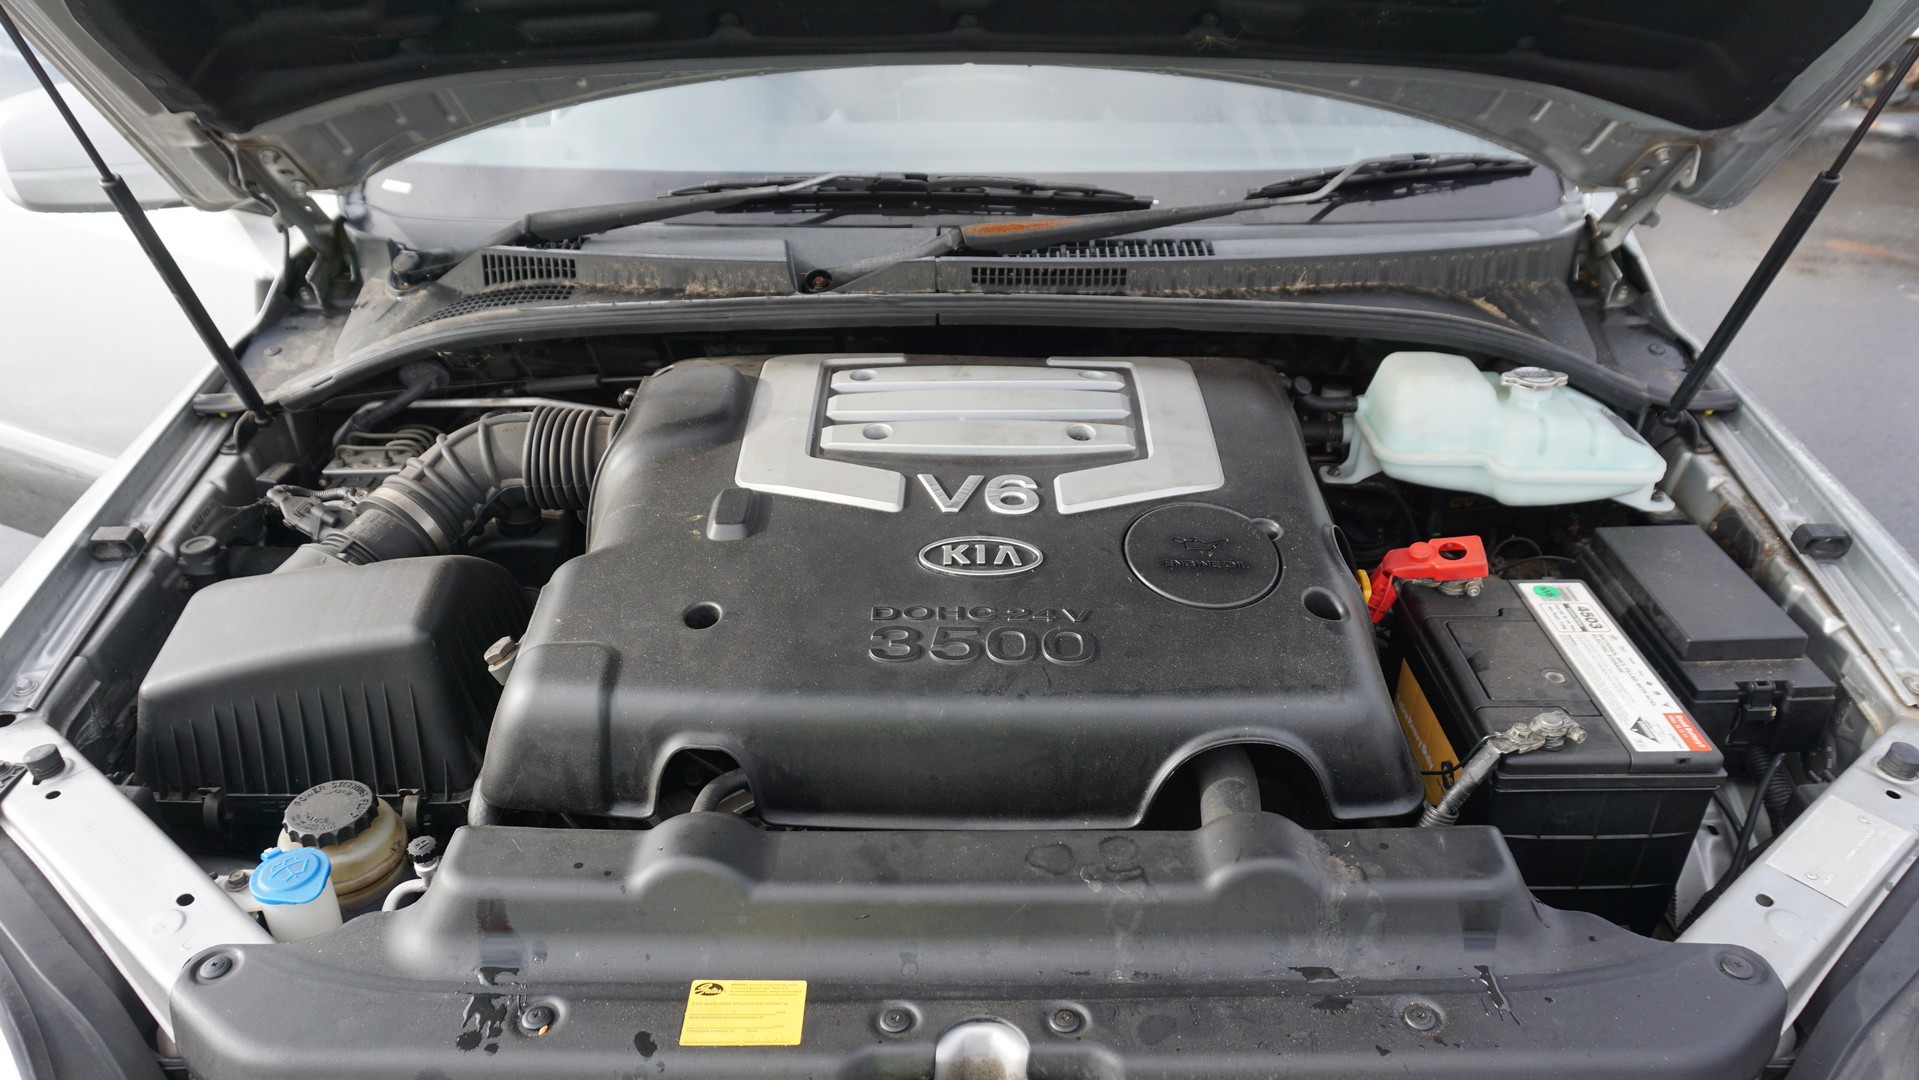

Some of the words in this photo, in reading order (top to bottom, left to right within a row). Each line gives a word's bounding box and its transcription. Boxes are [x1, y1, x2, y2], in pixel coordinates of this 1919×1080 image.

[917, 473, 1040, 515] V6
[942, 544, 1022, 566] KIA
[870, 605, 997, 622] DOHC
[1006, 607, 1091, 623] 24V
[1577, 605, 1603, 629] 4503
[868, 625, 1097, 665] 3500
[293, 785, 326, 806] POWER
